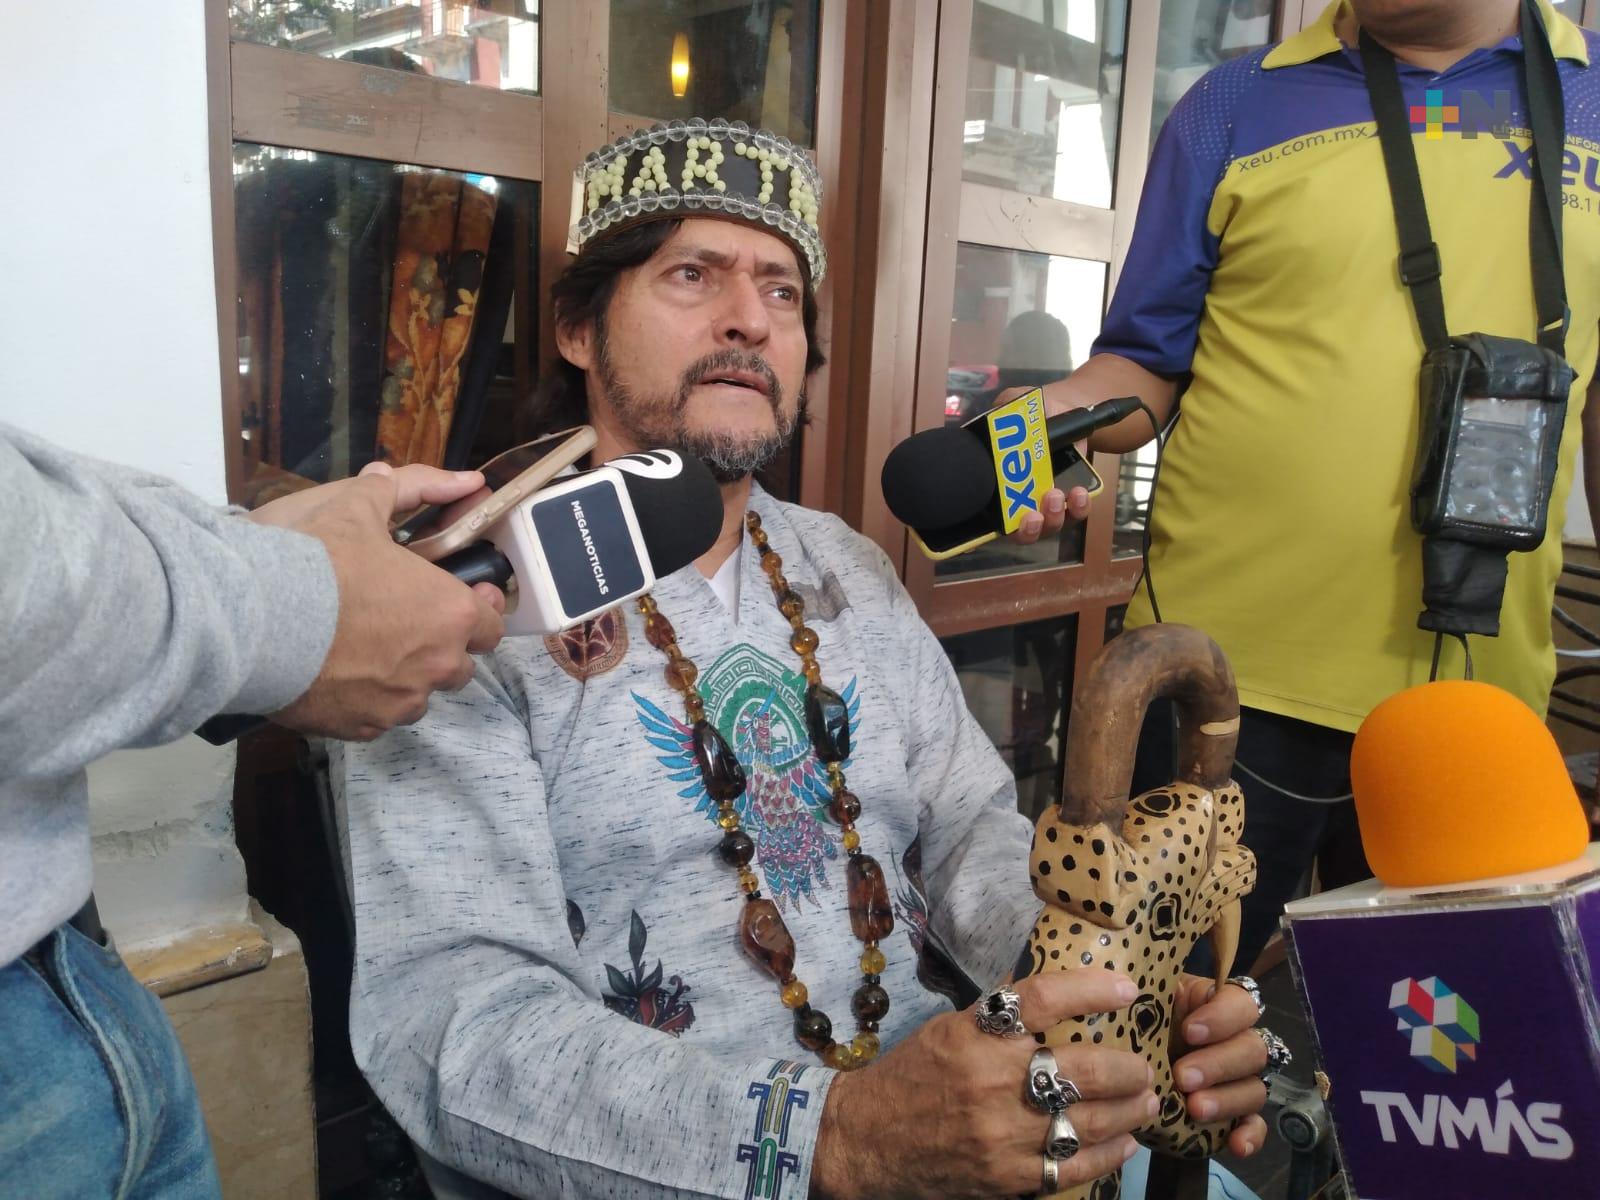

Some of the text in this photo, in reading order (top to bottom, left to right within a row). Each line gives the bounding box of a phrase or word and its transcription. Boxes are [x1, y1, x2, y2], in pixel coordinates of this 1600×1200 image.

[1237, 125, 1370, 172] xeu.com.mx
[993, 413, 1038, 519] xeu
[1026, 397, 1045, 460] 98.1 FM
[571, 500, 609, 596] MEGANOTICIAS
[1360, 1078, 1575, 1161] TVMÁS
